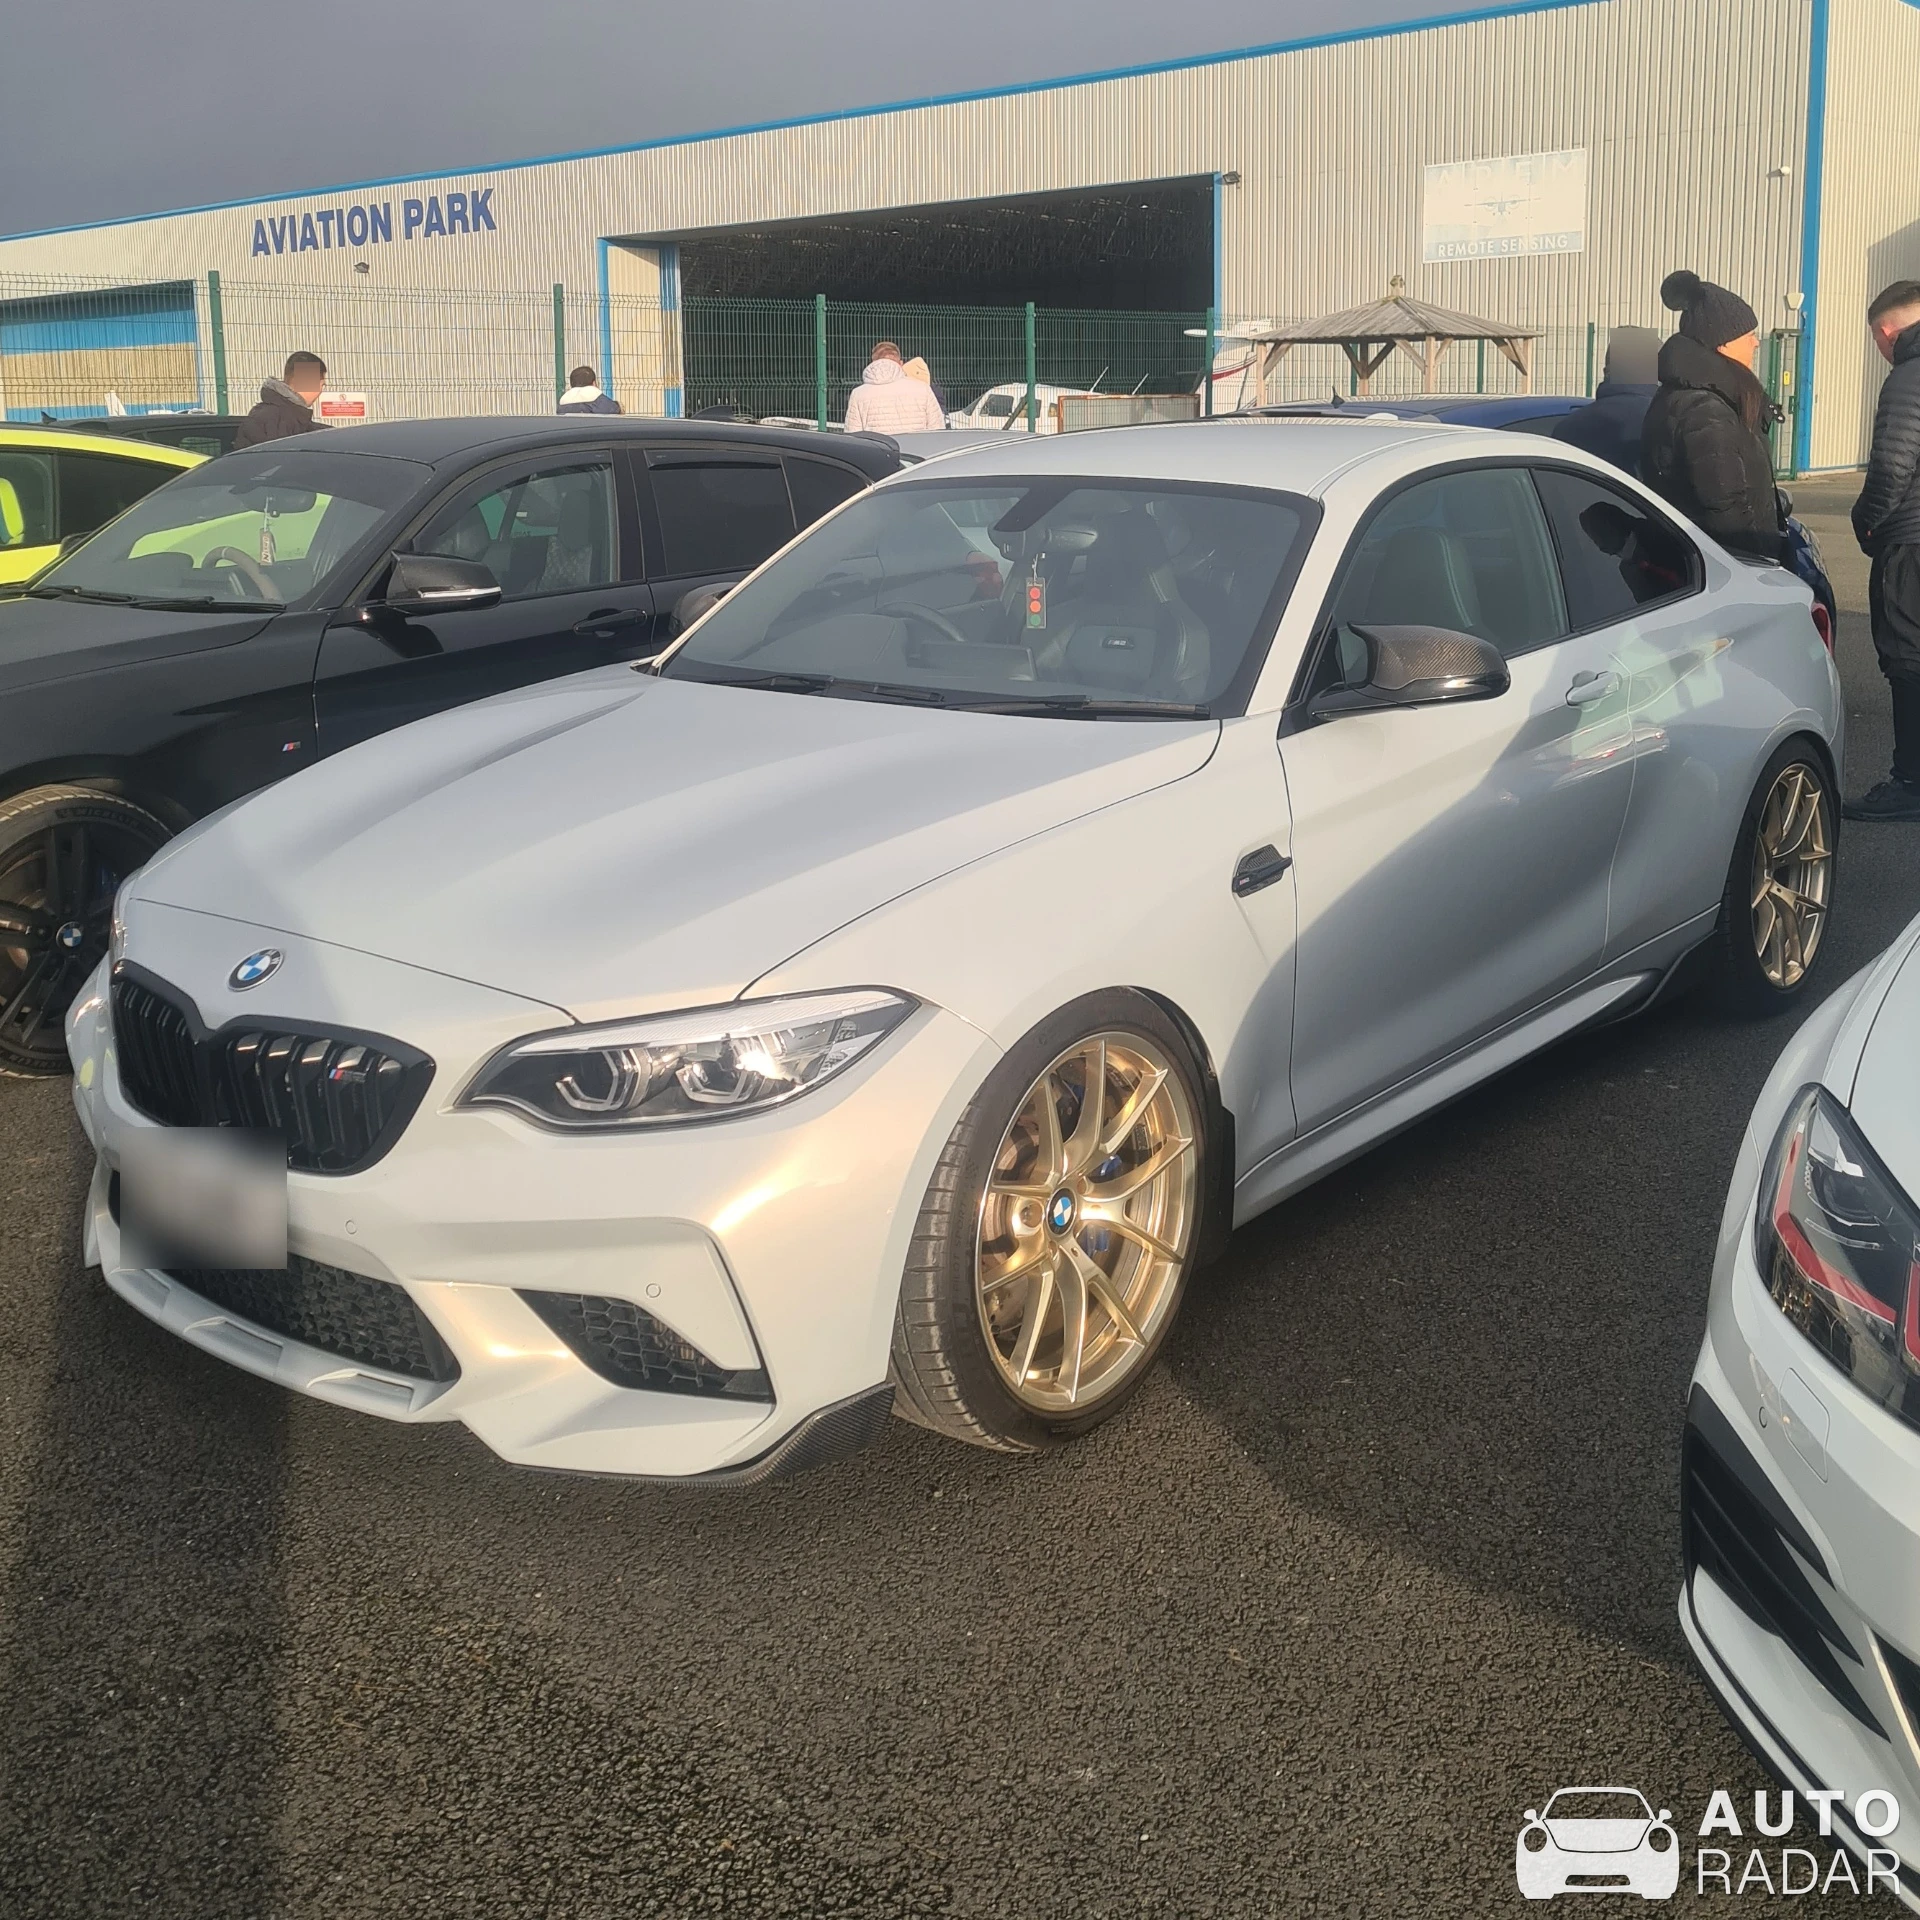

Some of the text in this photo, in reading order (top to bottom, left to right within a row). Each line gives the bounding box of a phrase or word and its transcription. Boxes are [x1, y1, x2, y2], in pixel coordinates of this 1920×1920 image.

[252, 188, 497, 258] AVIATION PARK
[1438, 234, 1569, 257] REMOTE SENSING
[954, 1202, 966, 1248] SPORT
